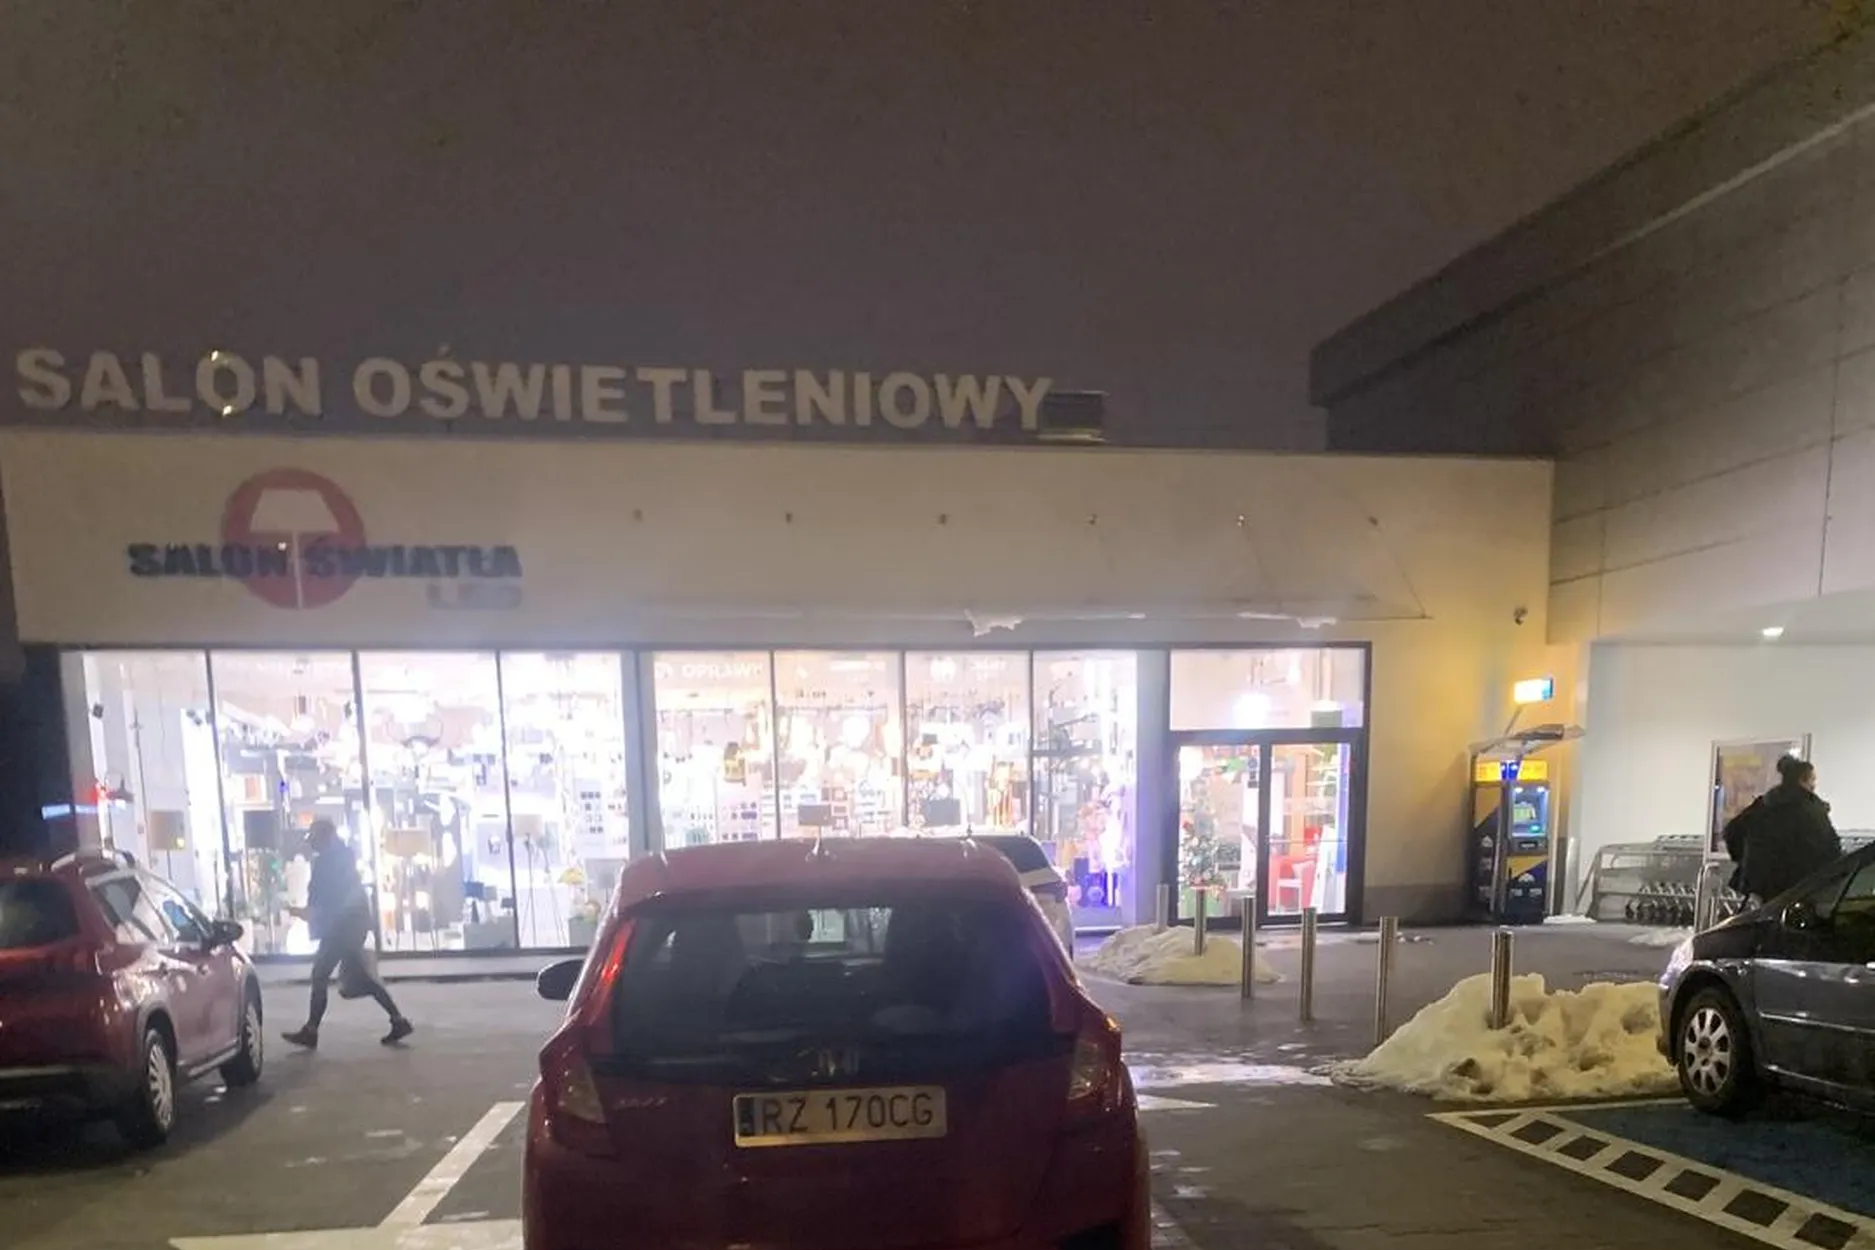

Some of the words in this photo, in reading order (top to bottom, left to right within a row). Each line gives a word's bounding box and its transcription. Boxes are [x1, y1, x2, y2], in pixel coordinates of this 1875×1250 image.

[16, 349, 323, 415] SALON
[352, 345, 1053, 431] OŚWIETLENIOWY
[128, 542, 287, 577] SALON
[761, 1096, 808, 1135] RZ
[825, 1093, 933, 1131] 170CG
